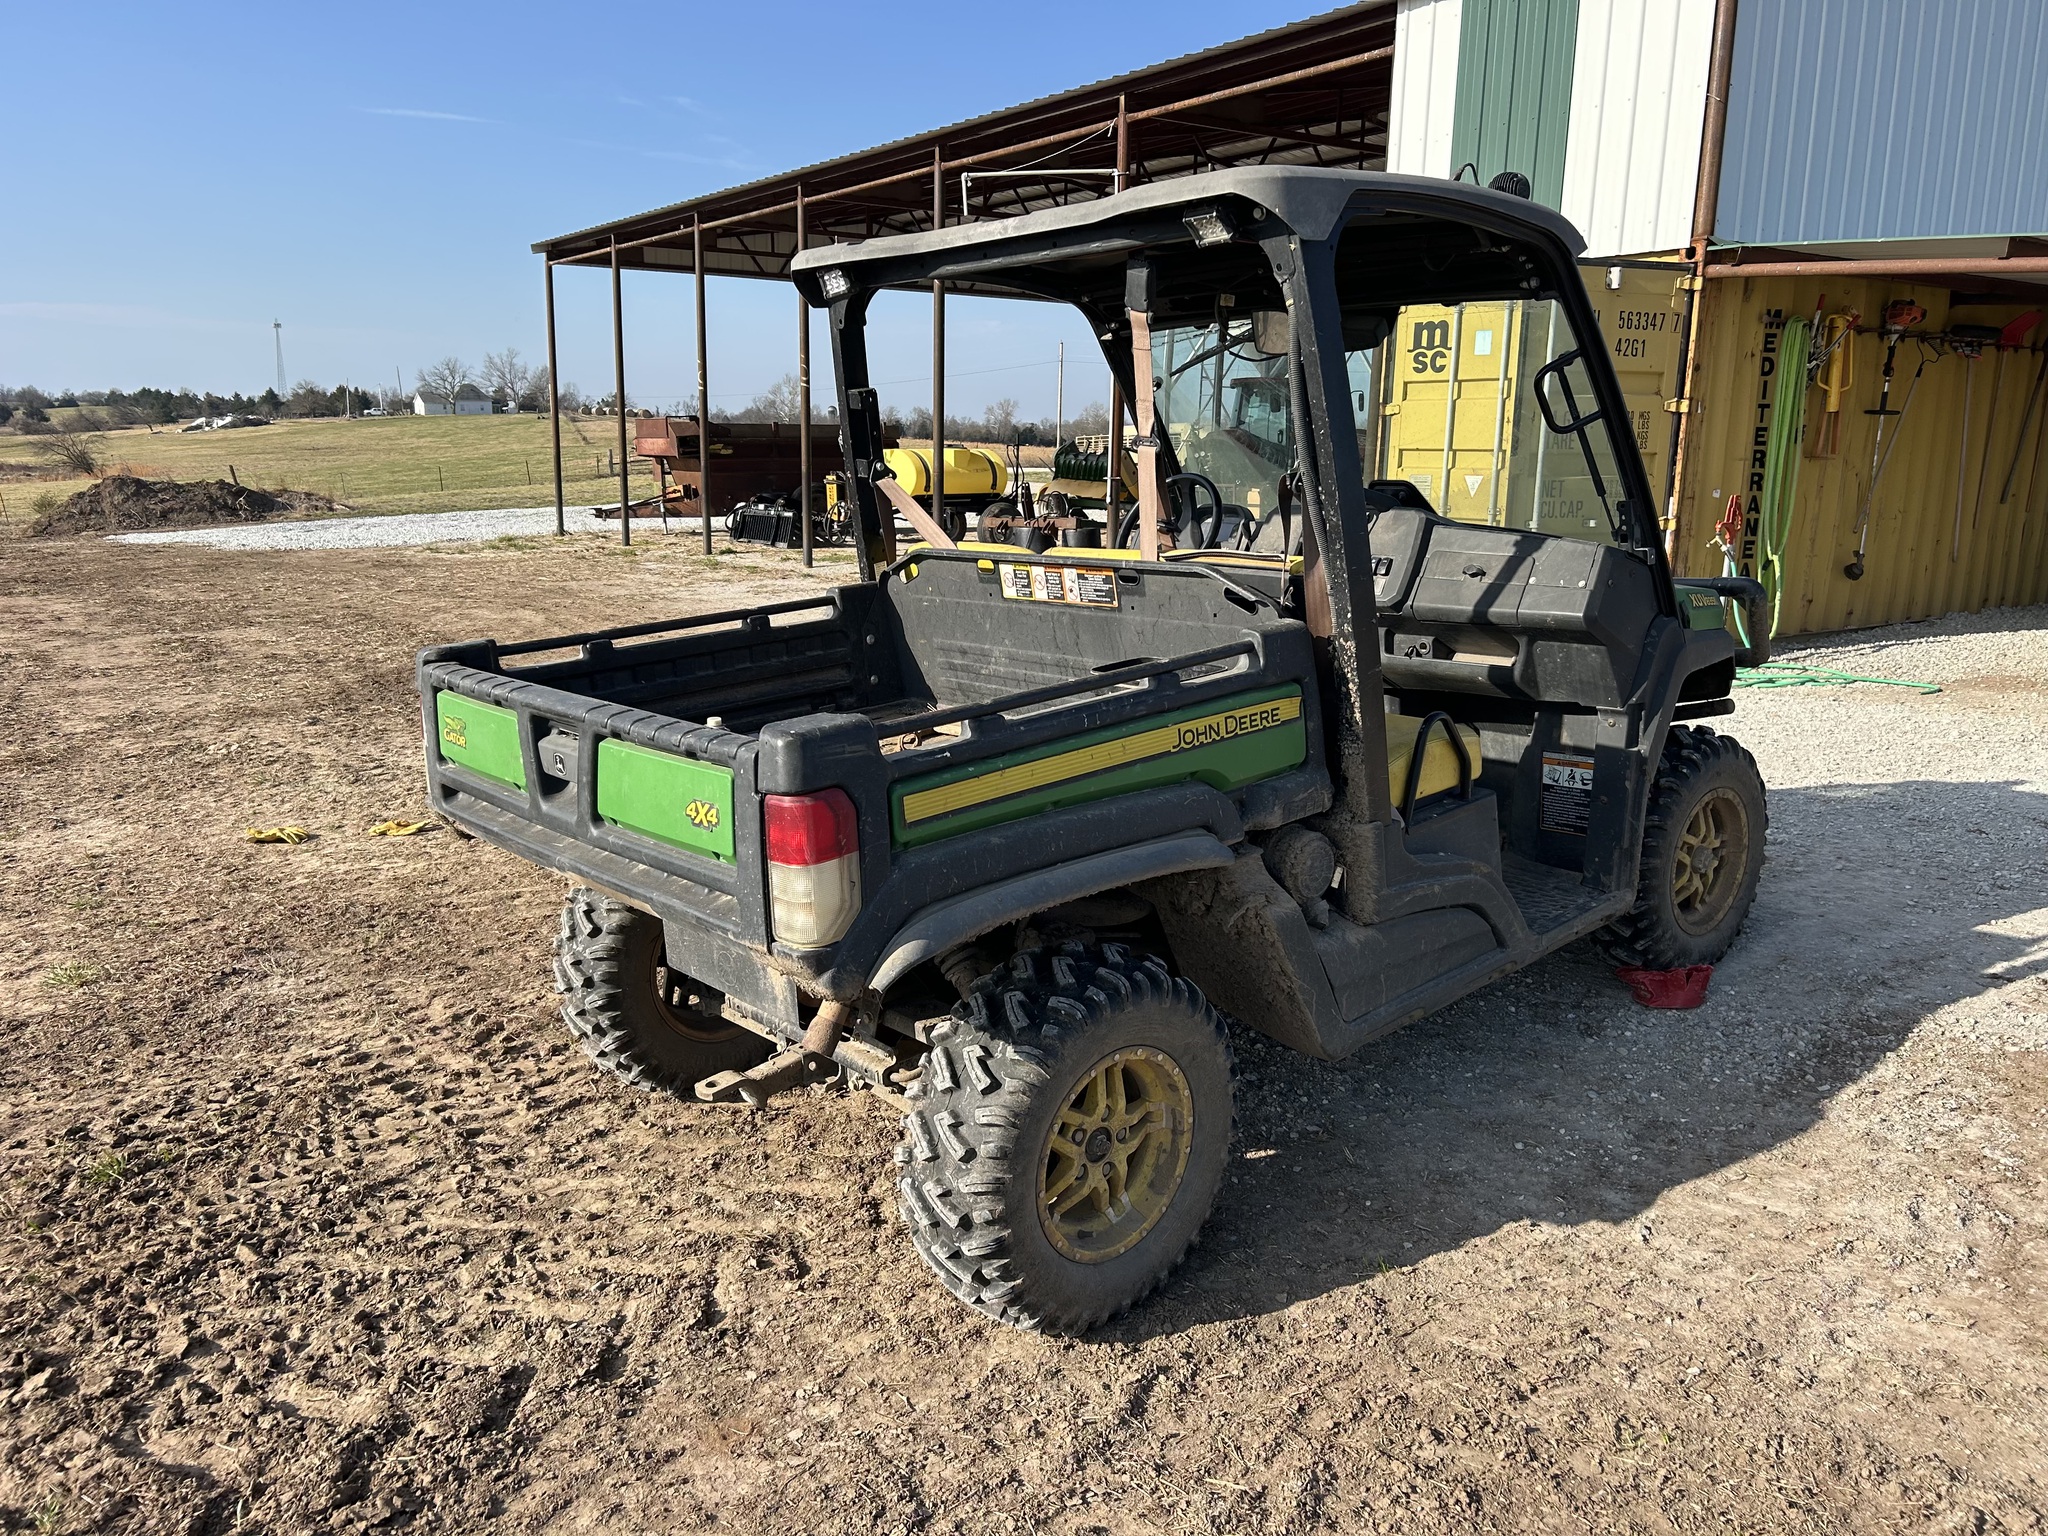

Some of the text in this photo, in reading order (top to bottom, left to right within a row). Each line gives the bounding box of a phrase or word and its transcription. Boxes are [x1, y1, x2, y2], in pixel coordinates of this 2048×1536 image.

[1618, 310, 1666, 332] 563347
[1614, 337, 1646, 358] 42G1
[1541, 479, 1566, 498] NET
[1171, 706, 1282, 750] JOHN DEERE
